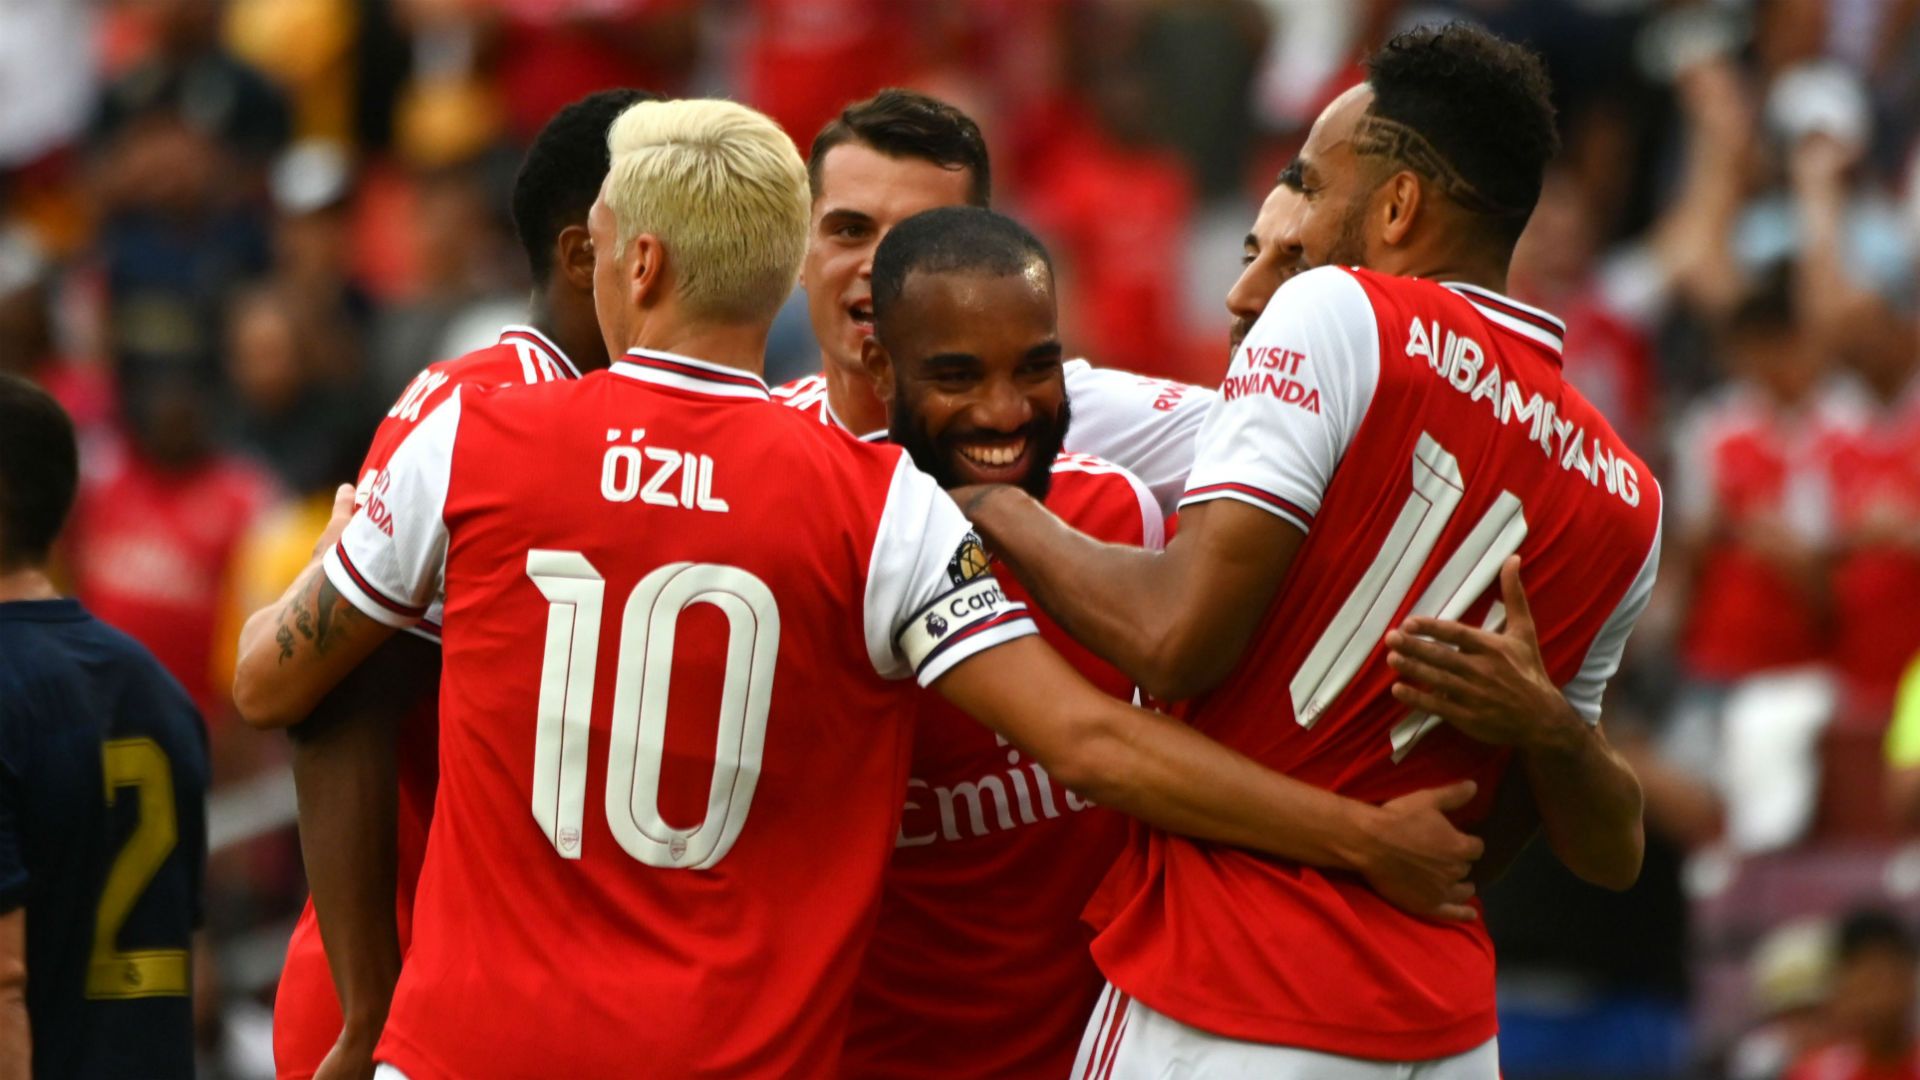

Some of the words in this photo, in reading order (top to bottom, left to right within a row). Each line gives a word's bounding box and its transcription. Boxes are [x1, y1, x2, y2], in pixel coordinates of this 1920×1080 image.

[1223, 373, 1320, 415] RWANDA
[1246, 347, 1306, 376] VISIT
[1405, 316, 1640, 508] AUBAMEYANG
[601, 428, 729, 512] ÖZIL
[1289, 430, 1528, 764] 14
[526, 548, 782, 870] 10
[86, 737, 190, 999] 2
